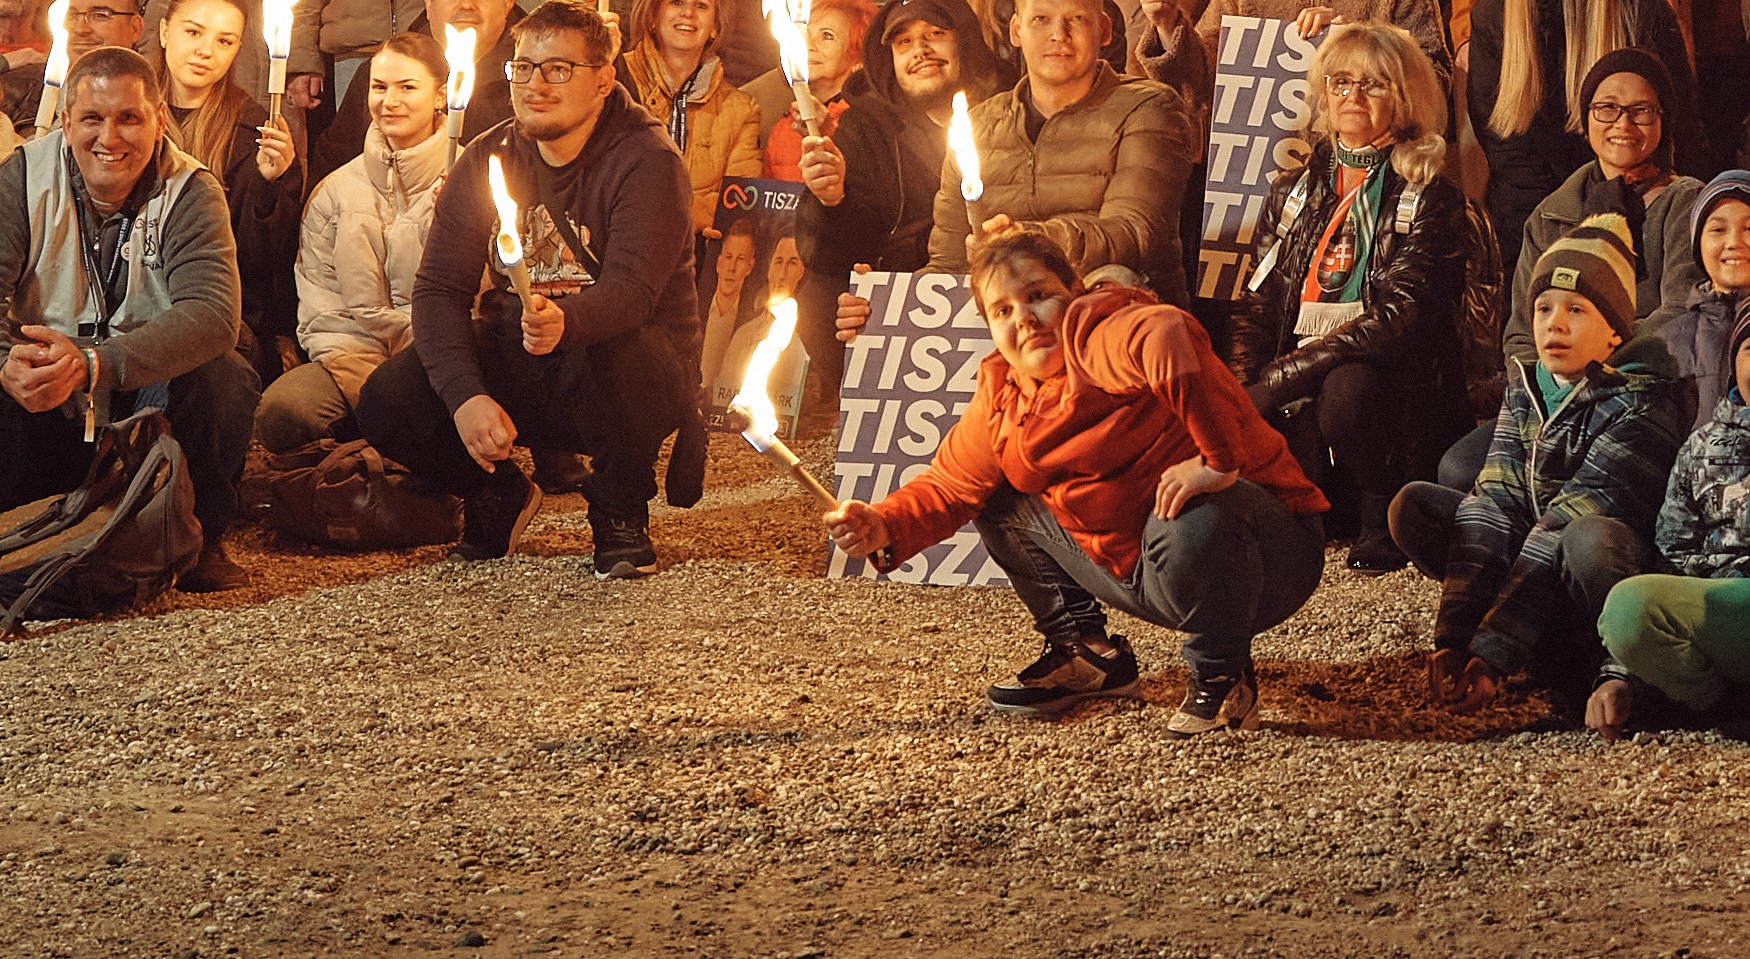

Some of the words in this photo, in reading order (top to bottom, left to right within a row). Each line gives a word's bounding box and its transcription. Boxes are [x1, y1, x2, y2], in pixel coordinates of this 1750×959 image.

[1220, 15, 1318, 72] TIS
[1215, 73, 1312, 131] TIS
[1209, 132, 1312, 185] TIS
[850, 271, 990, 329] TIS
[844, 335, 992, 393] TISZ
[838, 398, 968, 457] TIS
